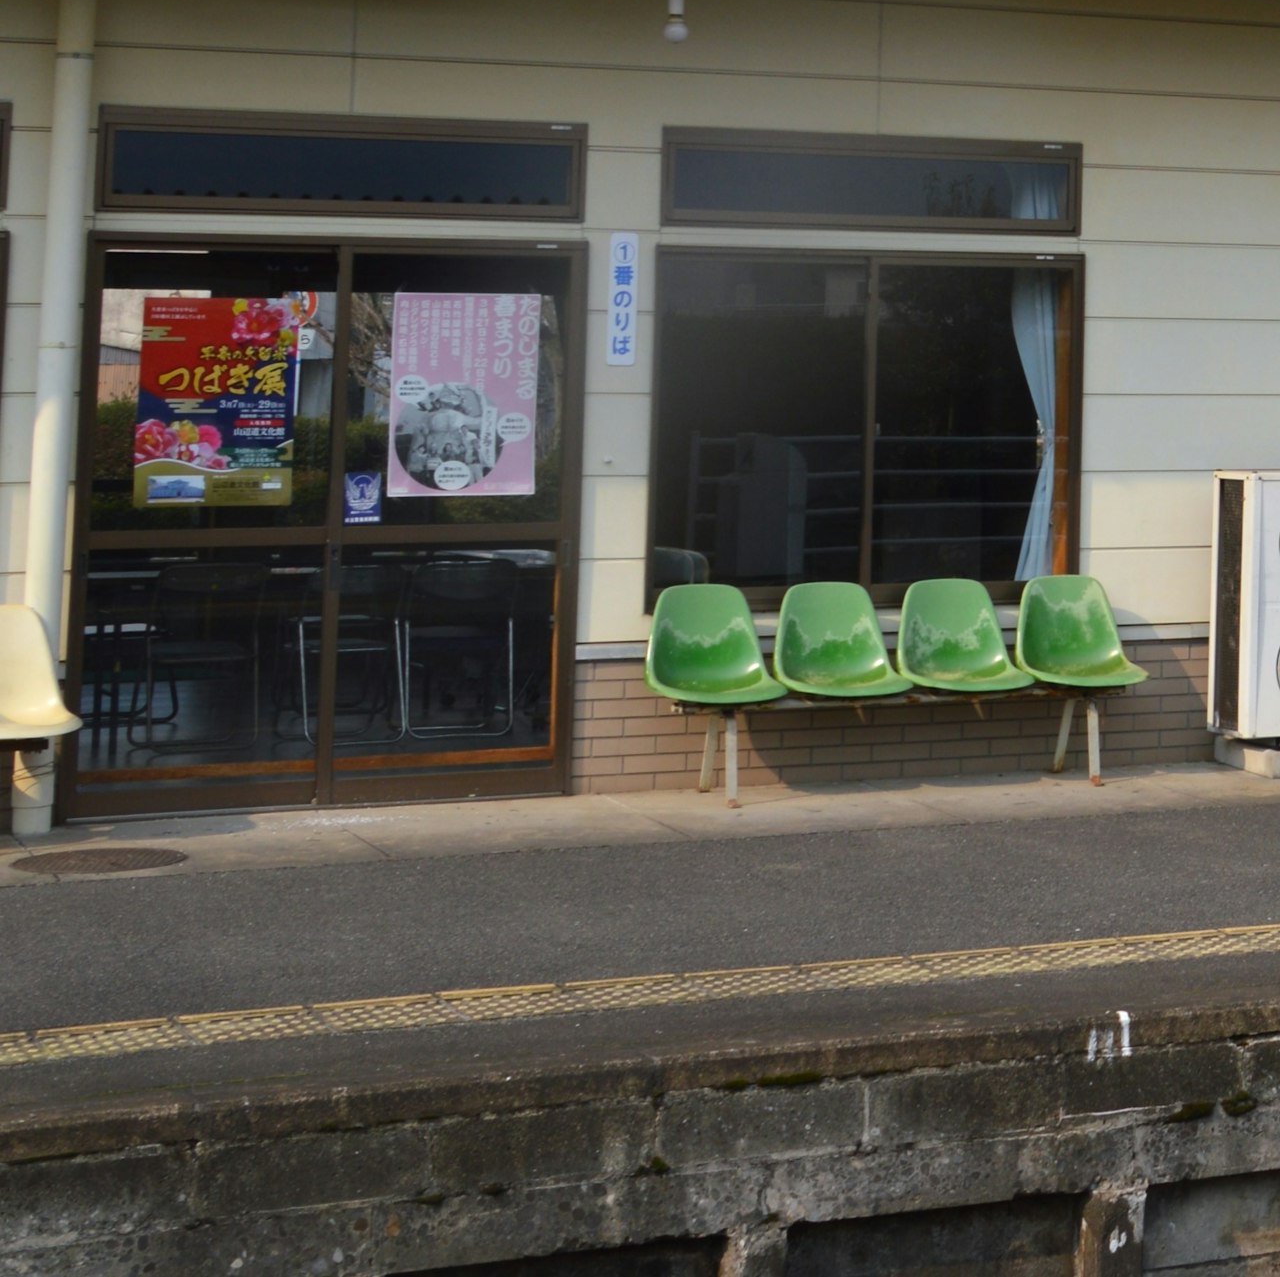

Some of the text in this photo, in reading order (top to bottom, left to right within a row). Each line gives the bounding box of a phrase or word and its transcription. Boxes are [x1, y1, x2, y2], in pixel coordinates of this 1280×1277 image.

[493, 295, 517, 379] 春まつり
[612, 241, 635, 355] ①番のりば
[158, 362, 289, 397] つばき展
[516, 295, 540, 400] たのしまる
